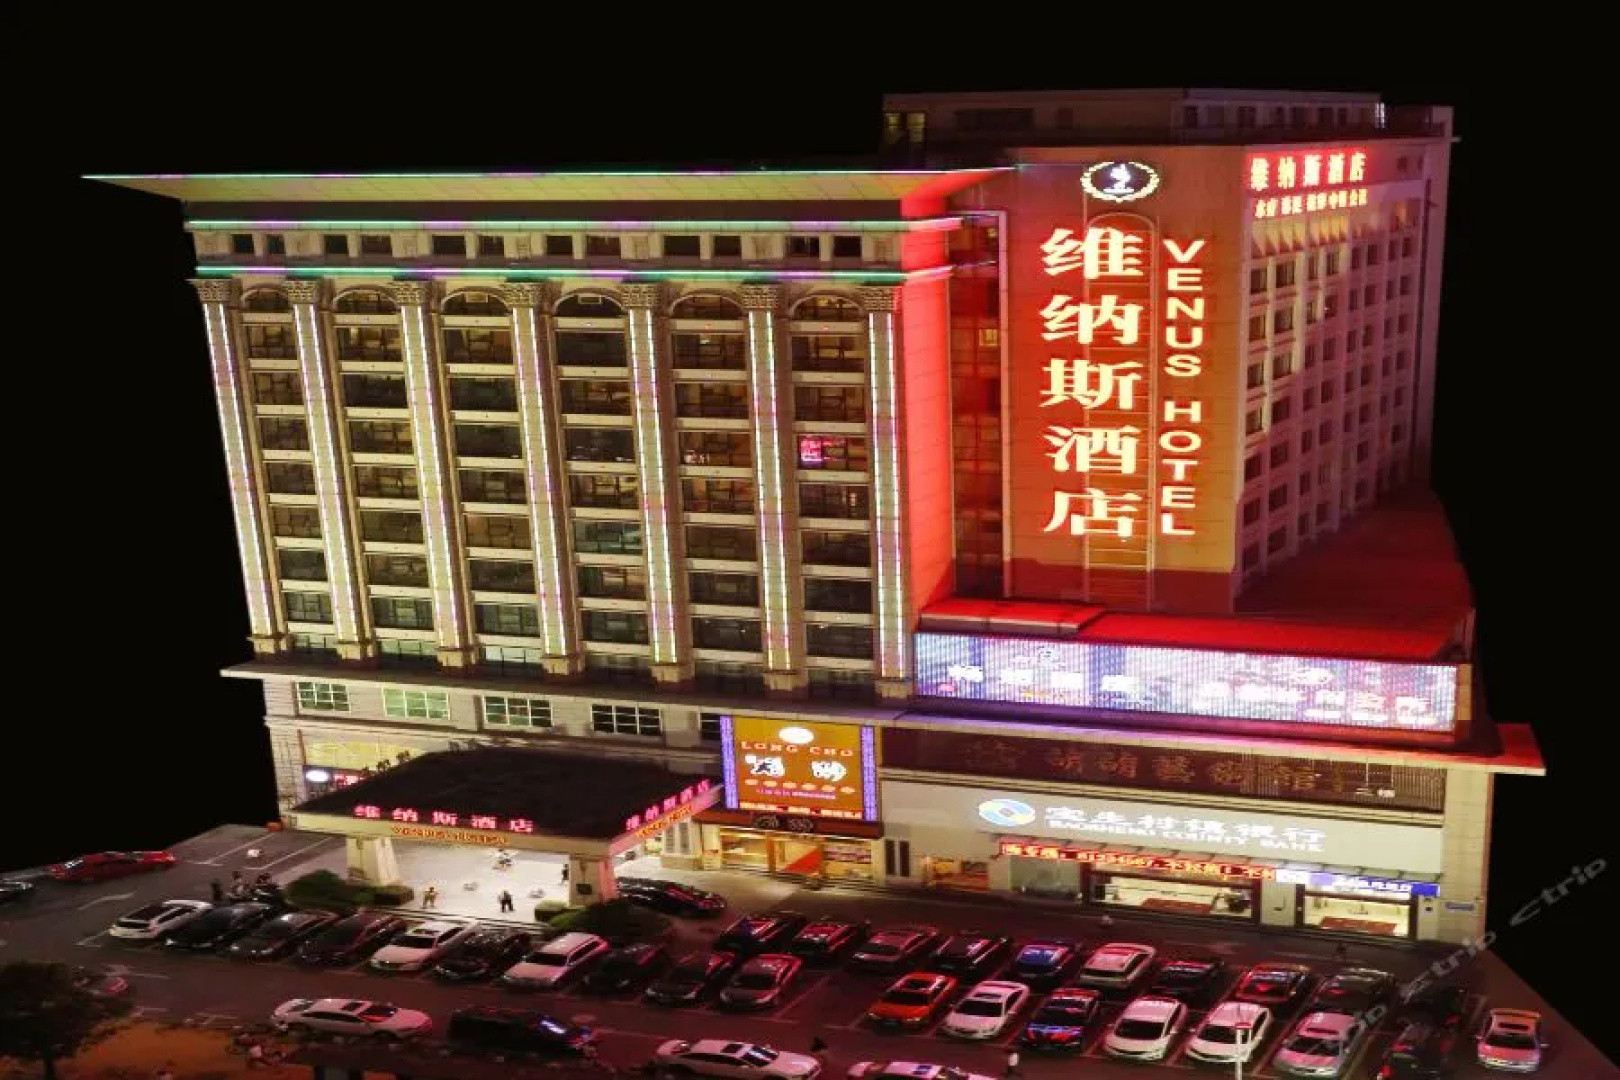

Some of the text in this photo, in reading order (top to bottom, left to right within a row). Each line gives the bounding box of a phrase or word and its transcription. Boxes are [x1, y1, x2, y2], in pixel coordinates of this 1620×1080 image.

[1039, 226, 1145, 538] 维纳斯酒店
[1159, 239, 1205, 536] VENUS HOTEL
[353, 804, 534, 833] 维纳斯酒店
